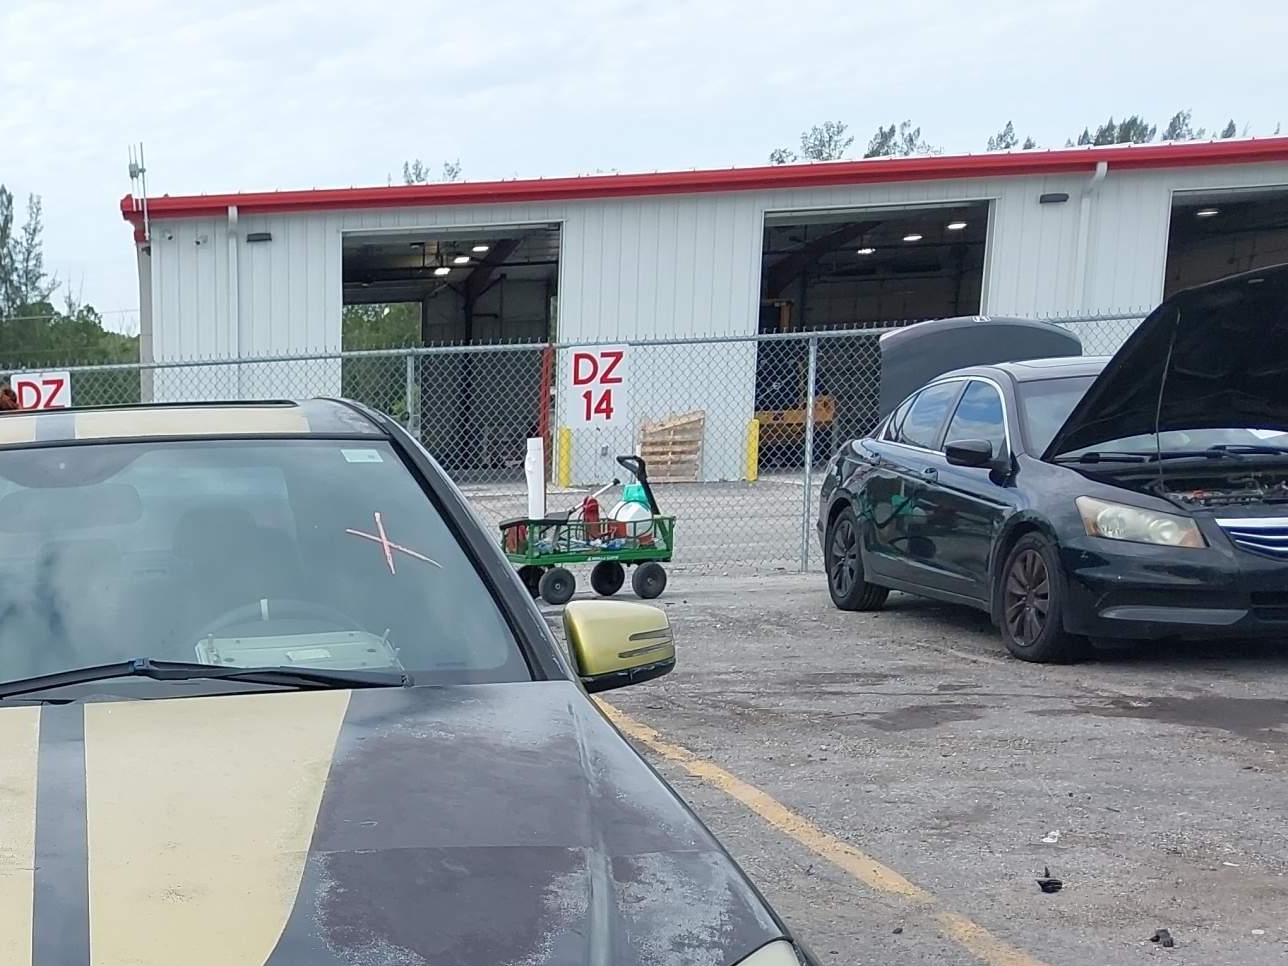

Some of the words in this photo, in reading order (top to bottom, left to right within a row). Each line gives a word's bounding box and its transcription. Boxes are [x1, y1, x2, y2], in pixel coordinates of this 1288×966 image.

[573, 351, 624, 385] DZ
[17, 379, 65, 409] DZ
[583, 389, 614, 421] 14
